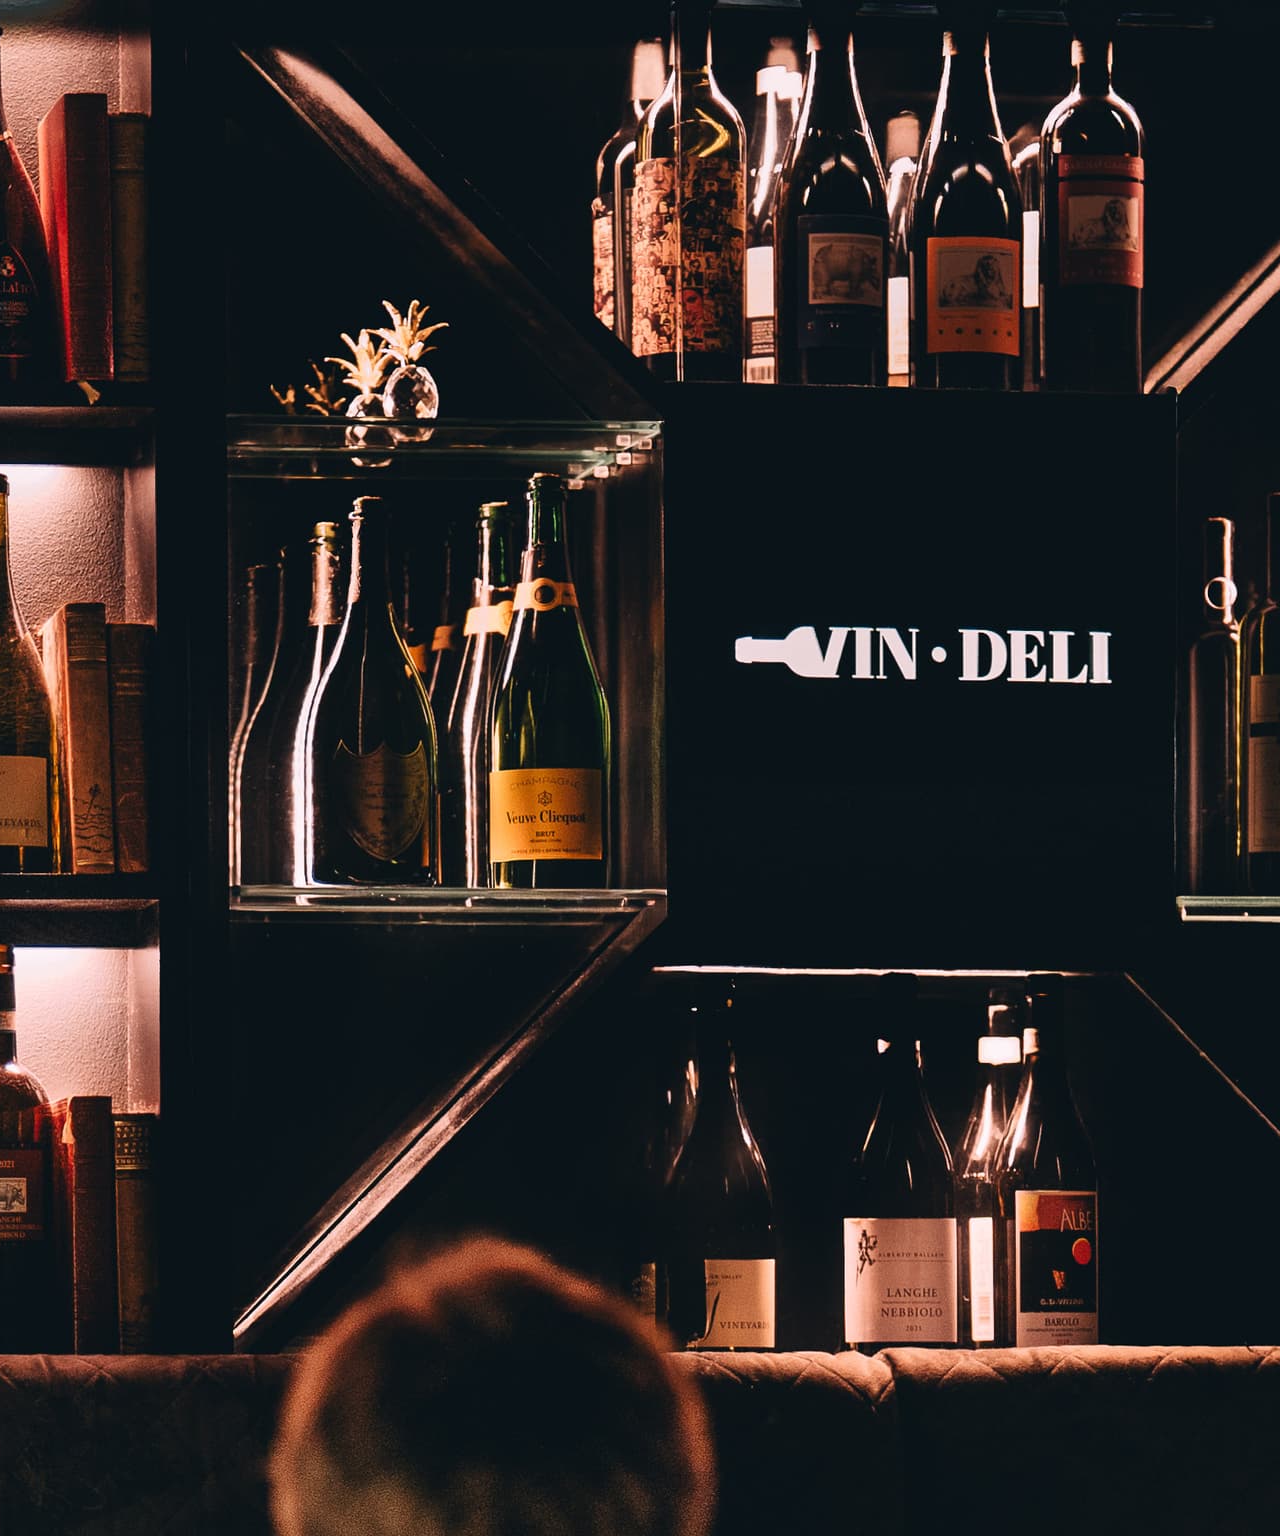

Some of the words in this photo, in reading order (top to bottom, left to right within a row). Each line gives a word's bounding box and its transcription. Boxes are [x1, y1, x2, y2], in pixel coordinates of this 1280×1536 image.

[813, 626, 920, 680] VIN
[958, 628, 1112, 684] DELI
[506, 811, 536, 824] Veuve
[539, 809, 586, 825] Clicquot
[1061, 1208, 1093, 1233] ALBE
[887, 1287, 938, 1298] LANGHE
[881, 1307, 943, 1318] NEBBIOLO
[1044, 1317, 1079, 1327] BAROLO
